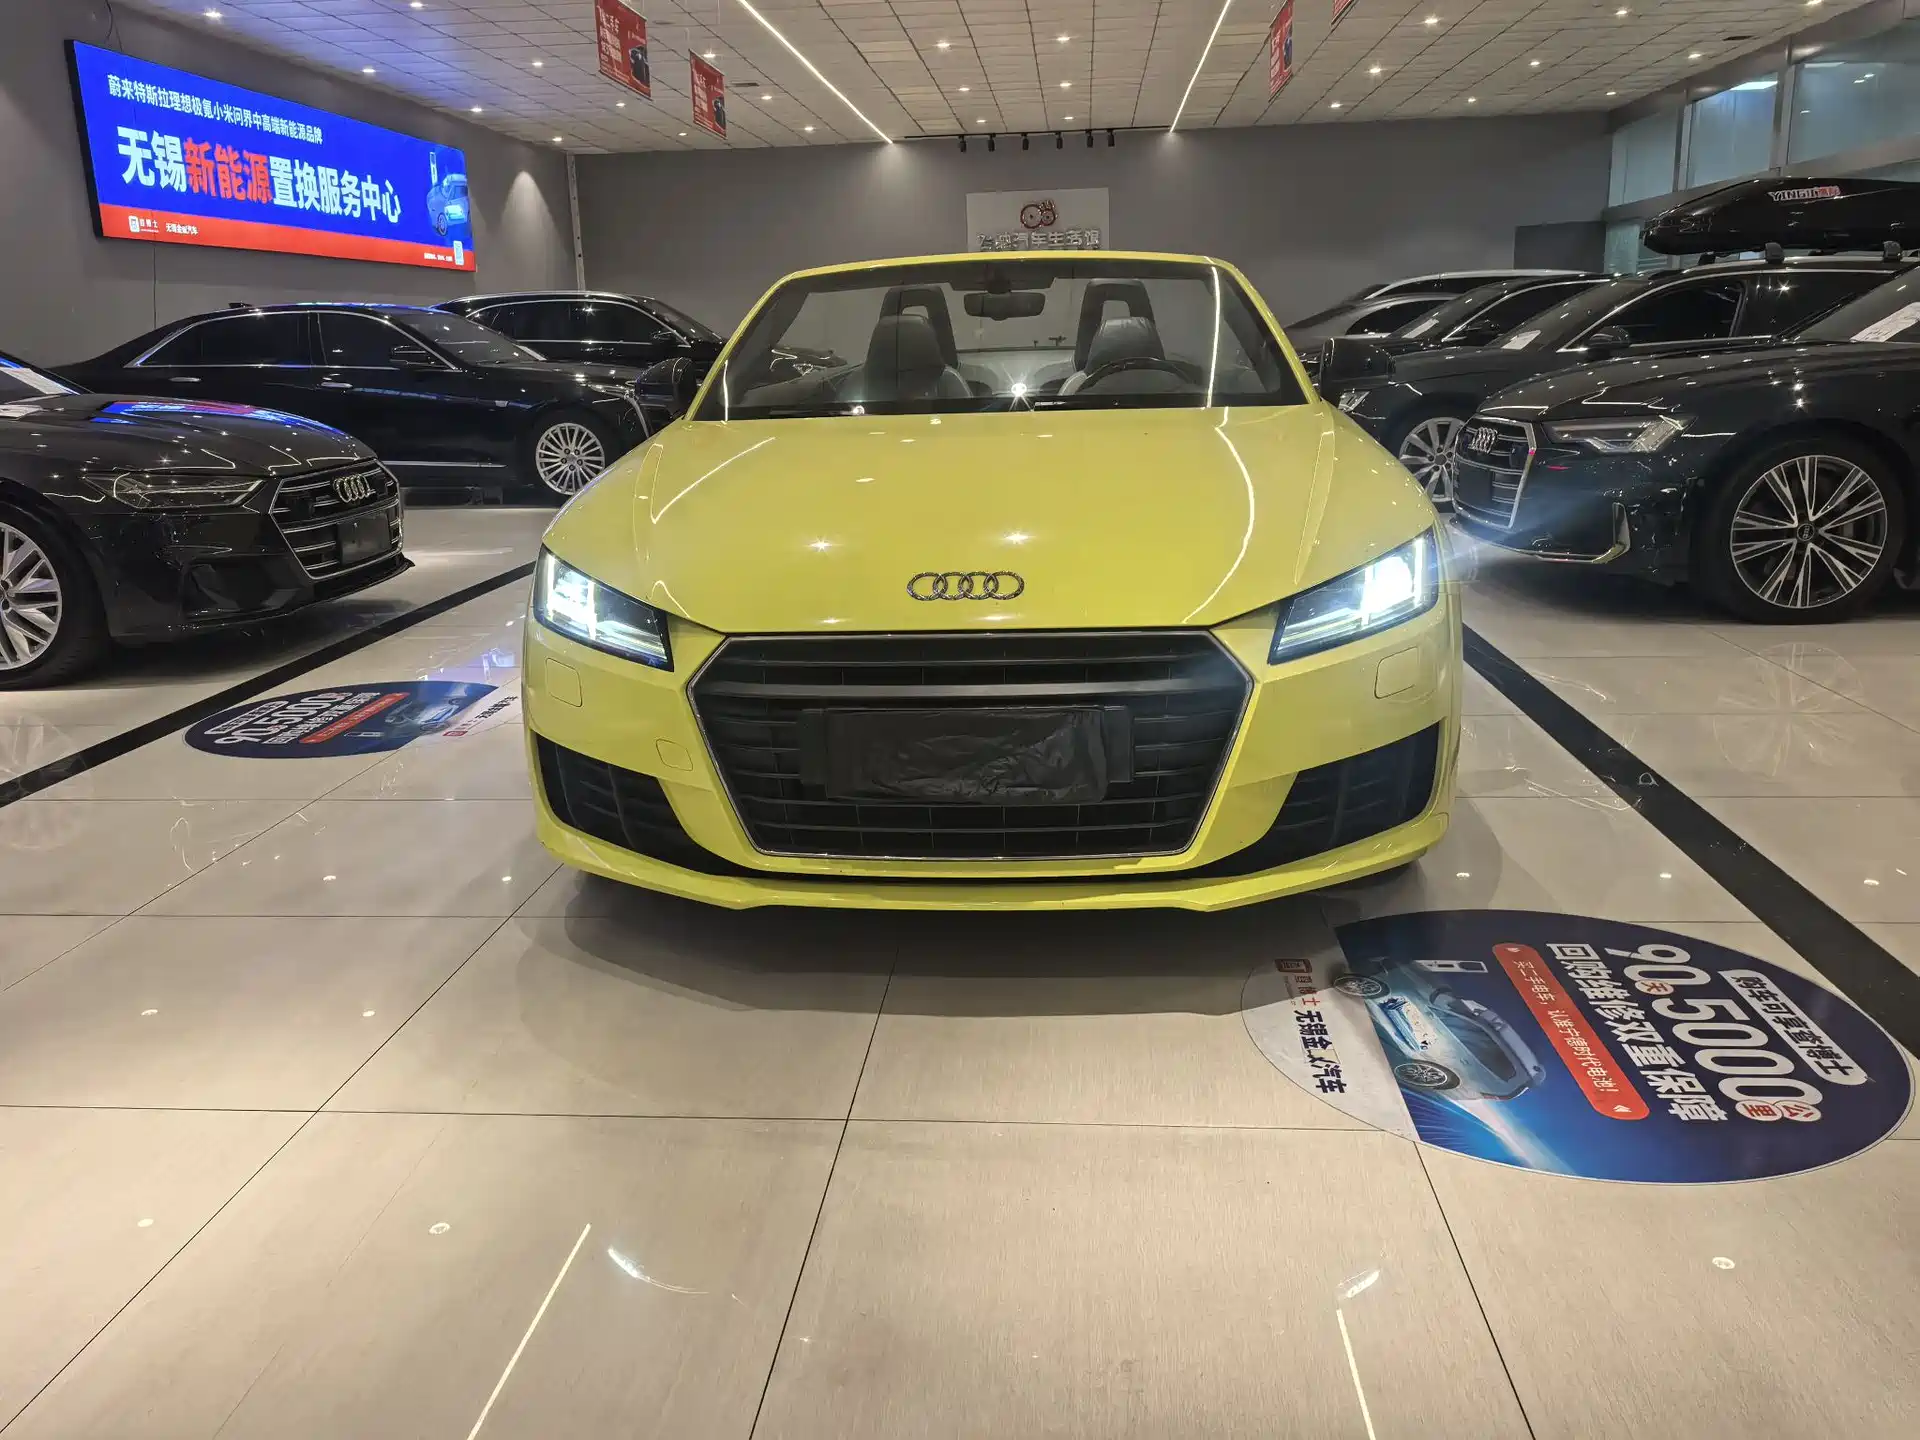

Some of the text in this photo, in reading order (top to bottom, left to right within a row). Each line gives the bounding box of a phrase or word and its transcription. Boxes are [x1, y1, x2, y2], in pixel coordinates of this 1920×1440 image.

[117, 126, 401, 223] 无锡新能源置换服务中心
[1546, 943, 1728, 1121] 回购维修双重保障
[1731, 975, 1854, 1077] 购车可享查博士
